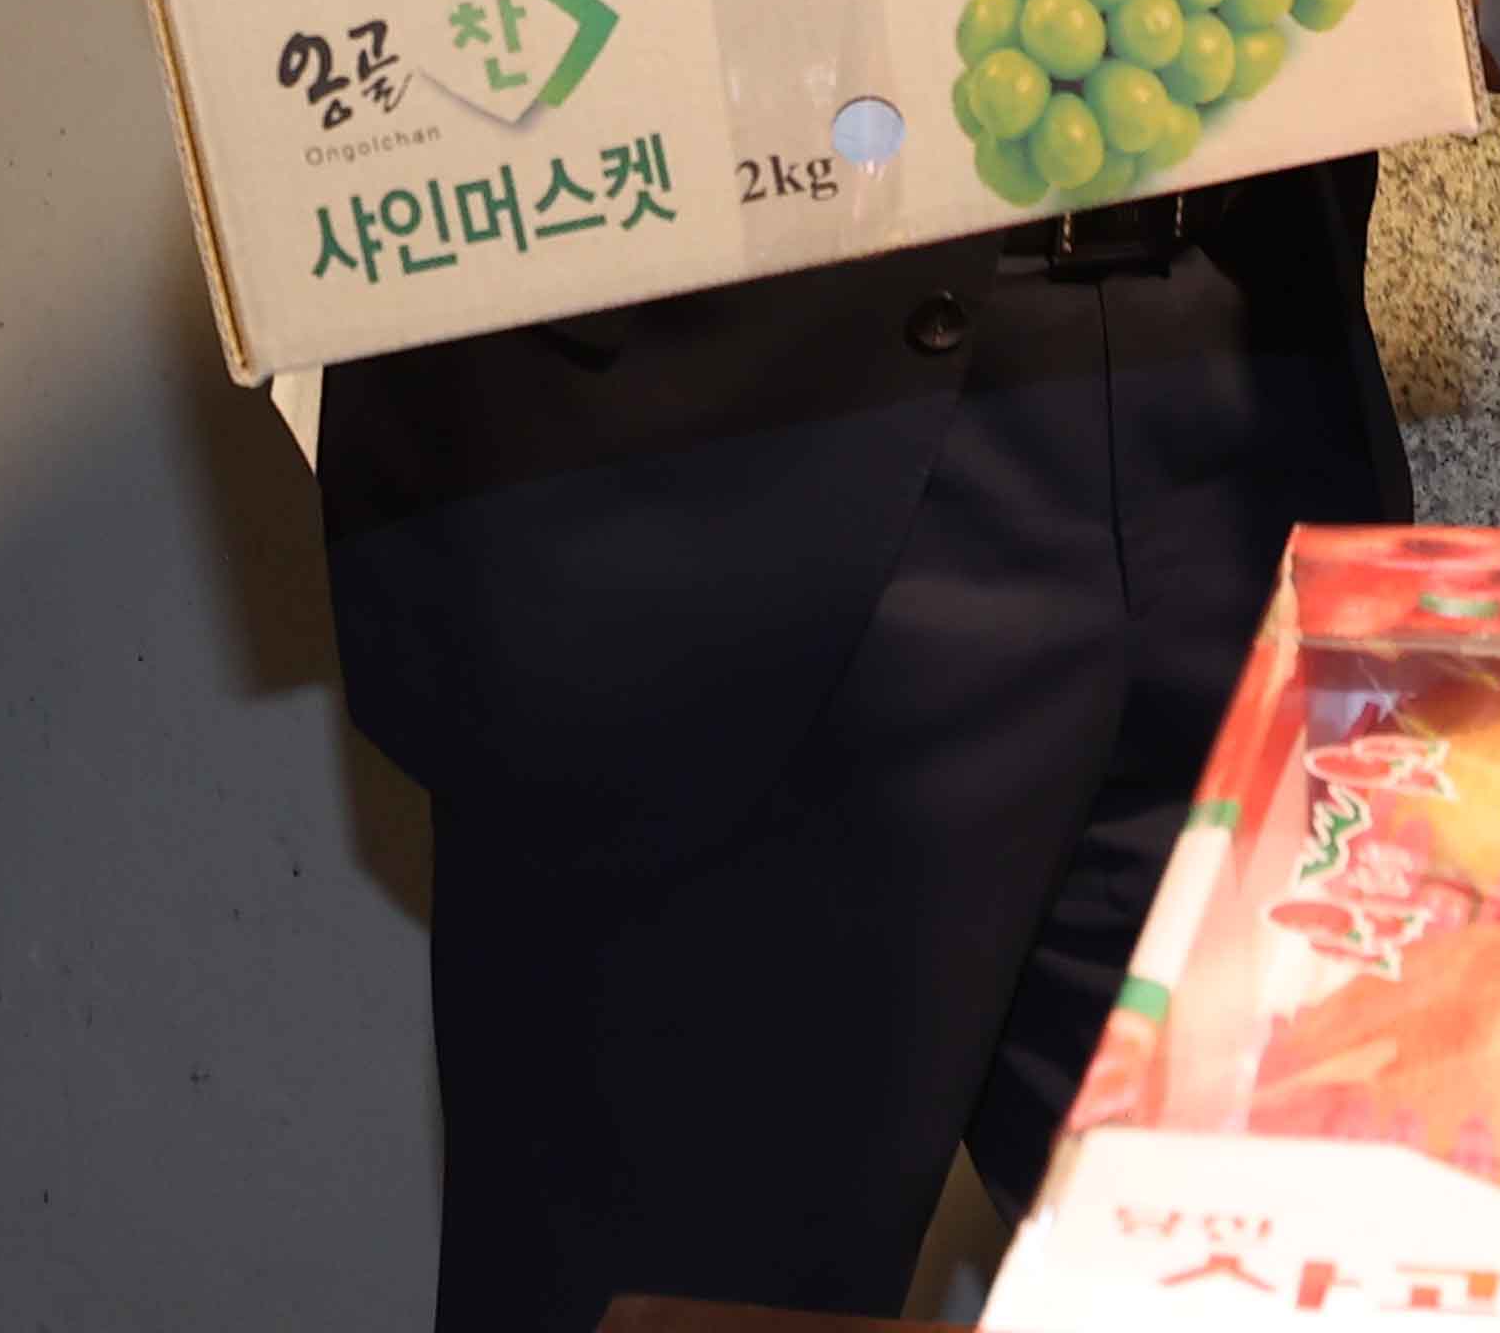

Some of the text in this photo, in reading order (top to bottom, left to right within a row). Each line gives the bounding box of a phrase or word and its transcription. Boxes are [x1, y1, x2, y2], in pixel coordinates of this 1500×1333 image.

[304, 125, 442, 168] Ongolchan
[736, 152, 839, 205] 2kg
[310, 132, 679, 286] 샤인머스켓
